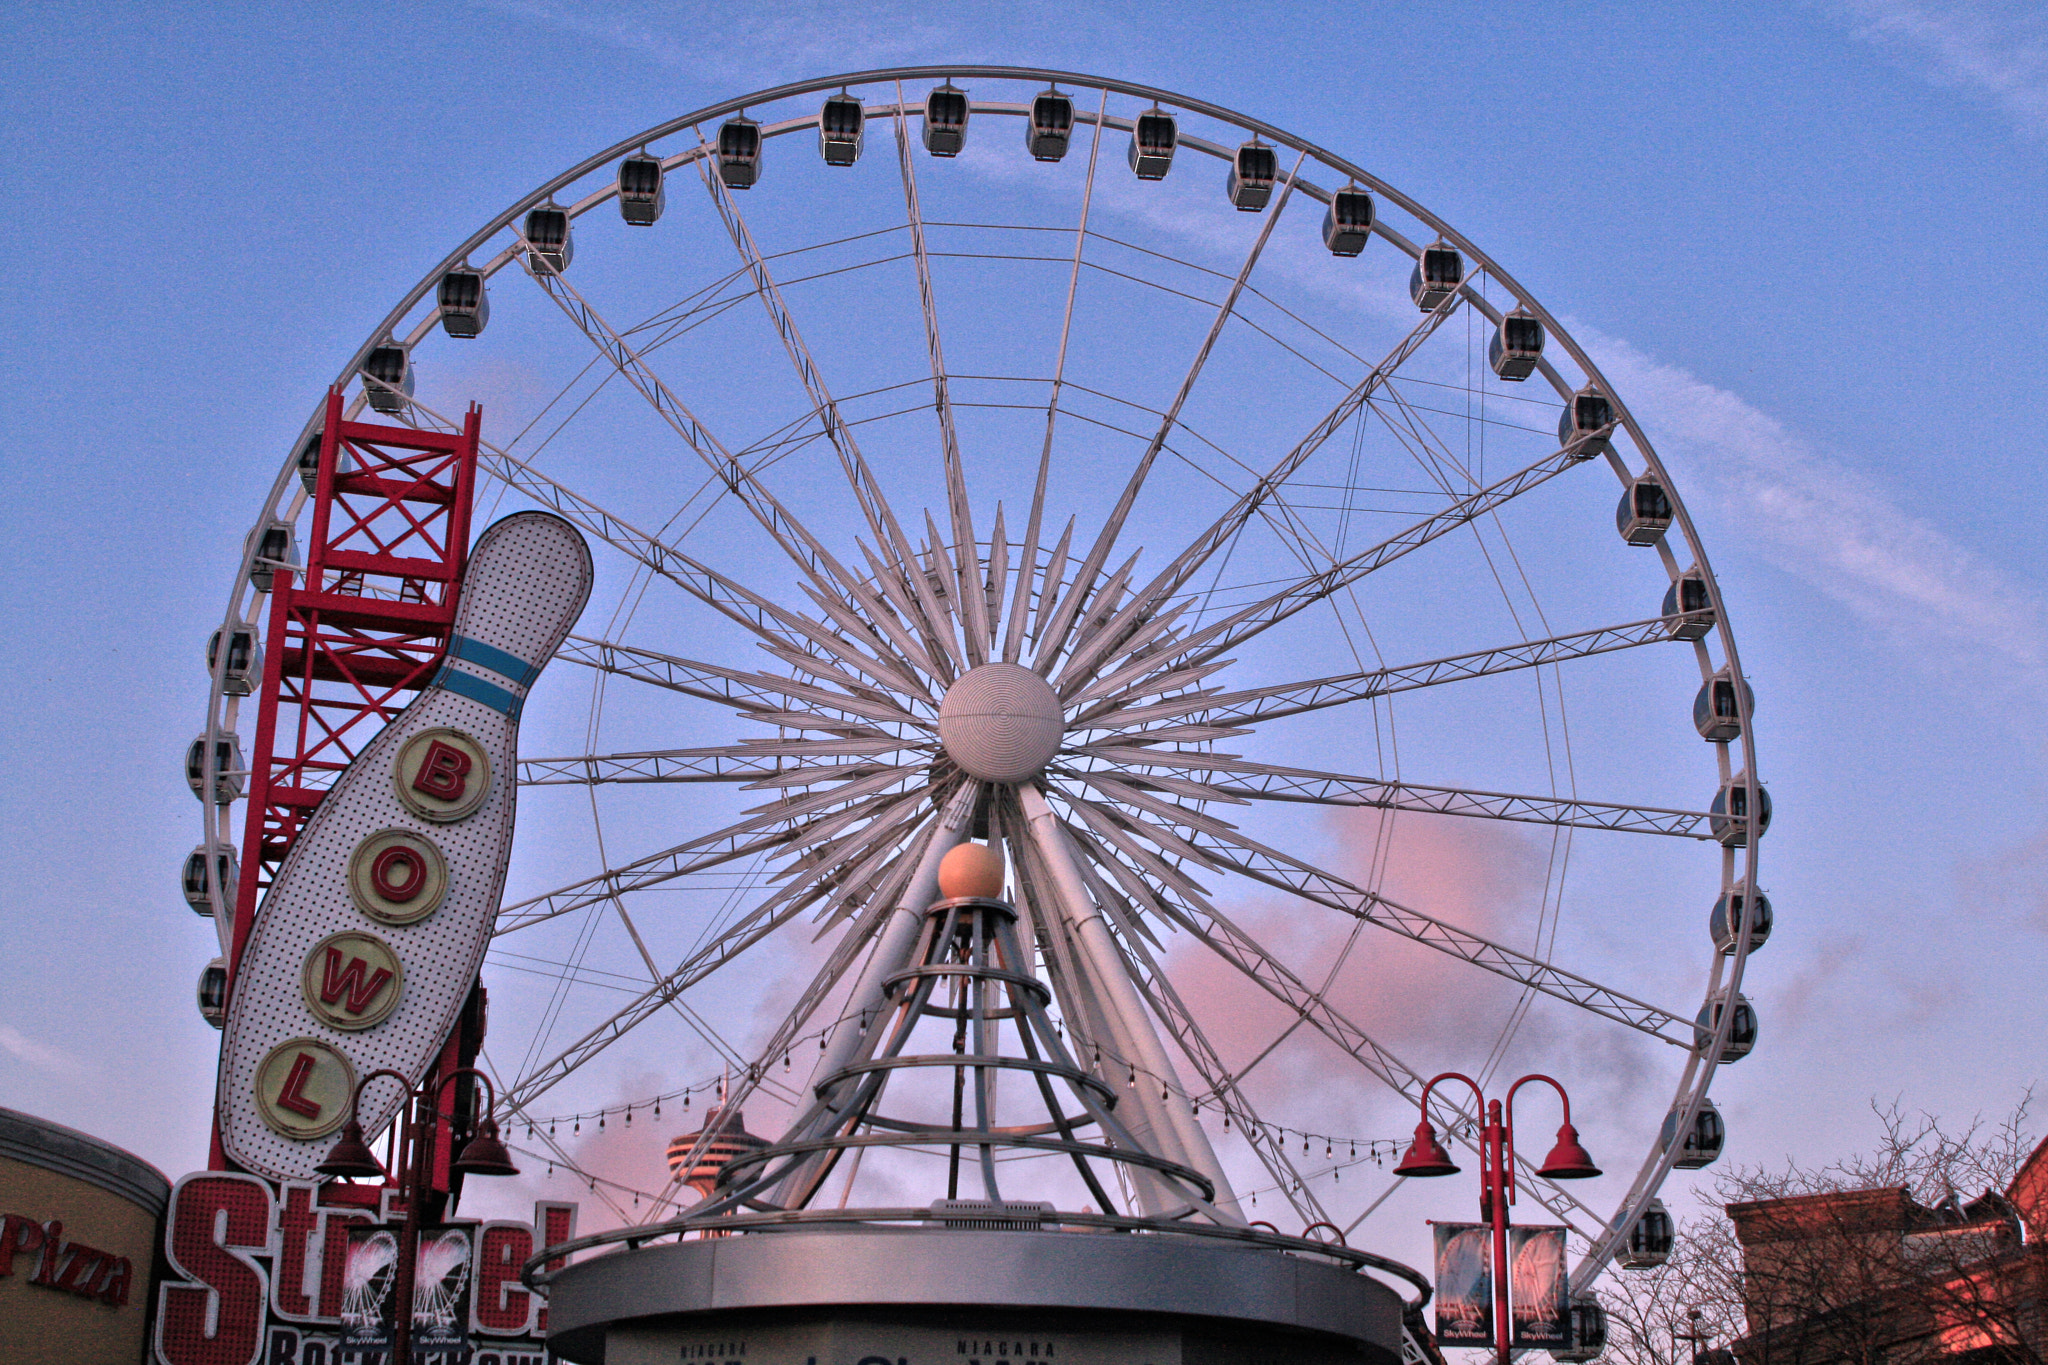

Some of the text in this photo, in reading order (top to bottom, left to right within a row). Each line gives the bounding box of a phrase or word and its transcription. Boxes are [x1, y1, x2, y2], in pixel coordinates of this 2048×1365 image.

[276, 739, 472, 1121] BOWL
[0, 1213, 132, 1308] Pizza
[346, 1335, 388, 1346] SkyWheel
[419, 1335, 462, 1346] SkyWheel
[1443, 1329, 1487, 1339] SkyWheel
[1520, 1331, 1563, 1341] SkyWheel
[680, 1342, 746, 1359] NIAGARA
[957, 1340, 1054, 1357] NIAGARA
